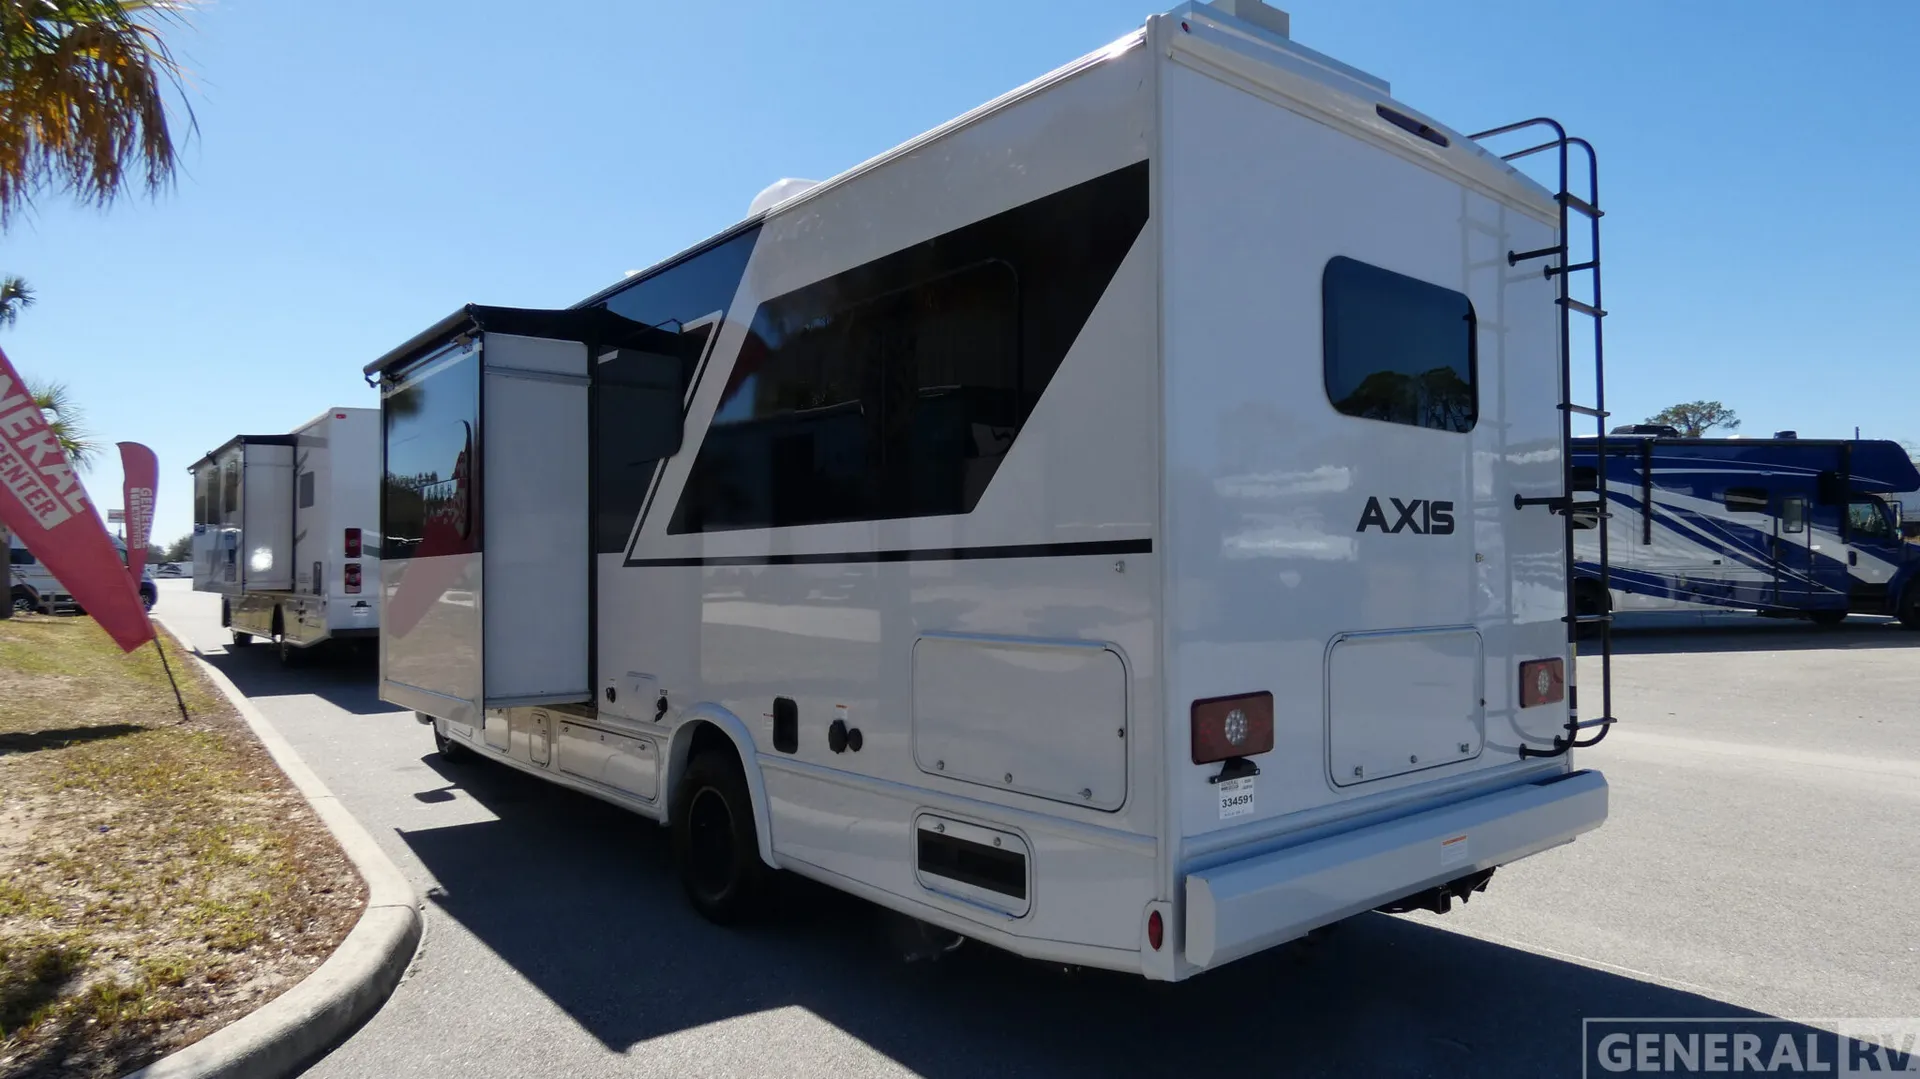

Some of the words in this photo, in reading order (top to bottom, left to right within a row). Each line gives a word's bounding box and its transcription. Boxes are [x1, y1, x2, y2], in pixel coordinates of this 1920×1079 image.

[0, 373, 86, 514] NERAL
[1356, 496, 1454, 535] AXIS
[1221, 793, 1253, 808] 334591
